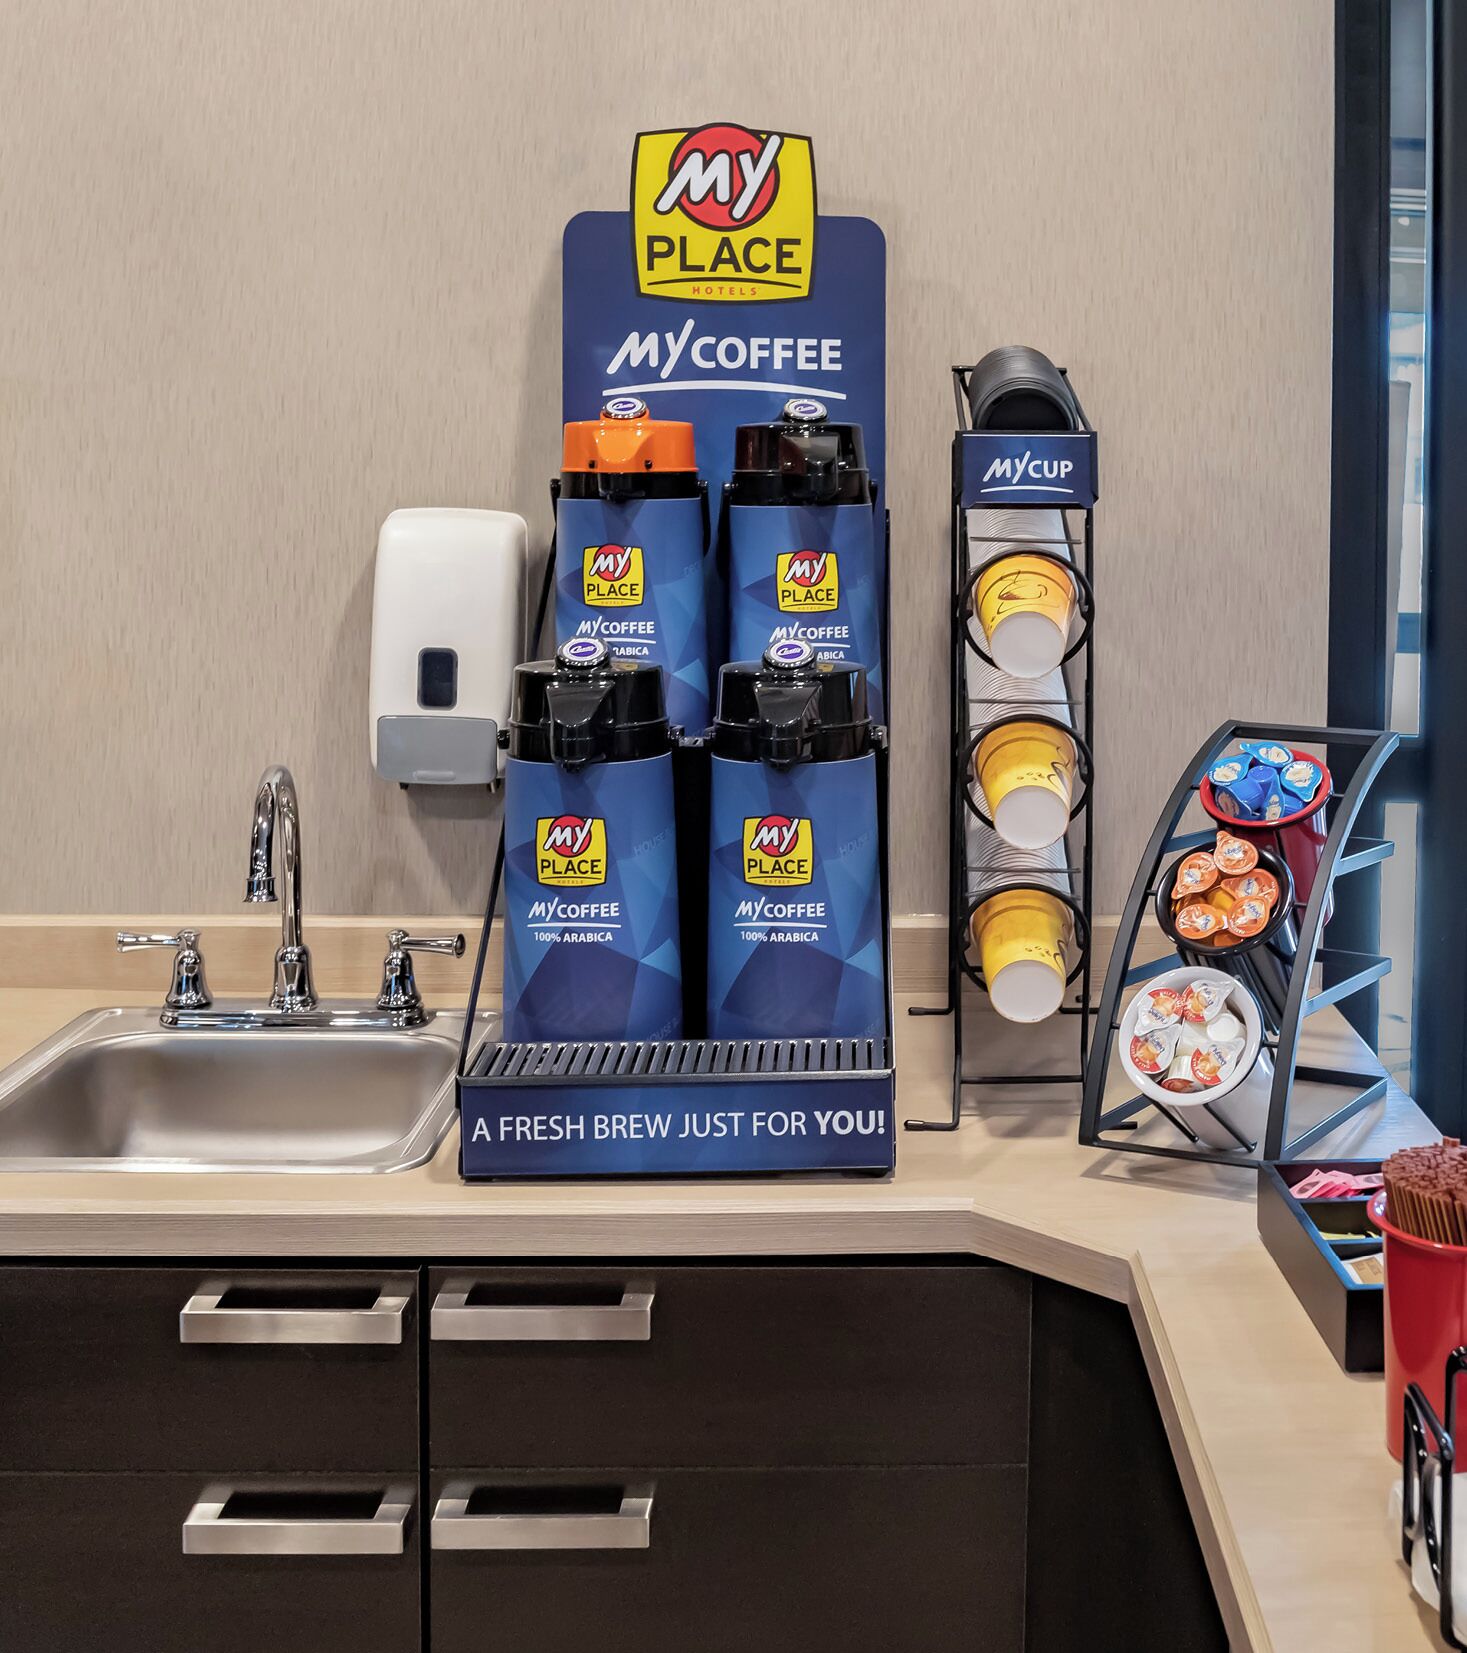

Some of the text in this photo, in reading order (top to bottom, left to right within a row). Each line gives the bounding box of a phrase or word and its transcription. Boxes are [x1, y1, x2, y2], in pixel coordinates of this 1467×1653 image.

[647, 235, 802, 274] PLACE
[692, 286, 758, 296] HOTELS
[587, 583, 640, 597] PLACE
[781, 588, 835, 602] PLACE
[816, 650, 845, 661] ABICA
[540, 859, 602, 875] PLACE
[747, 858, 809, 875] PLACE
[534, 932, 613, 943] 100% ARABICA
[740, 931, 819, 943] 100% ARABICA
[471, 1110, 886, 1142] A FRESH BREW JUST FOR YOU!
